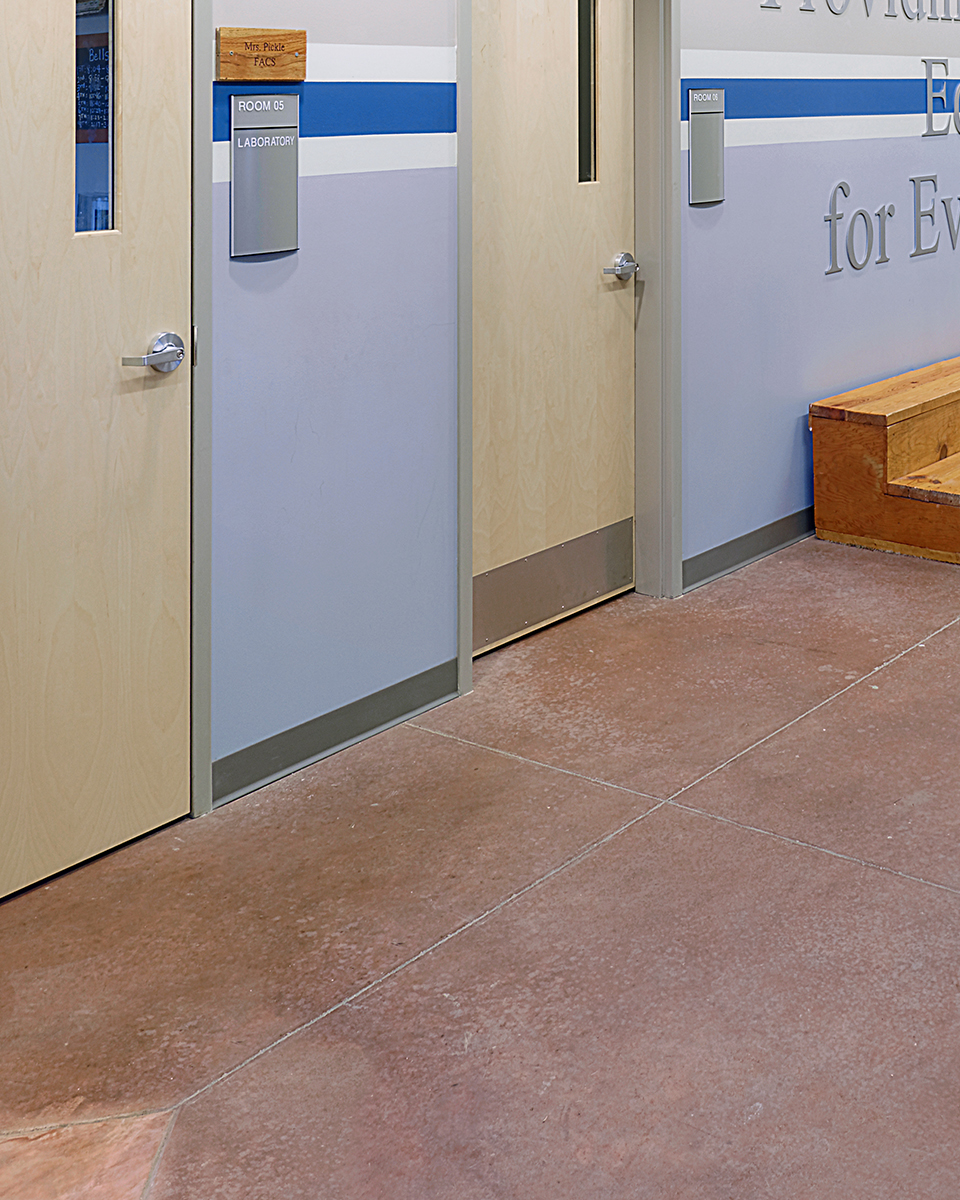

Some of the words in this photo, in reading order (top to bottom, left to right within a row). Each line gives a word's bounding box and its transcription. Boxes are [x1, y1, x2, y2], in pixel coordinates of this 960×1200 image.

[244, 42, 261, 52] Mrs.
[263, 42, 285, 52] Pickle
[254, 57, 276, 67] FACS
[693, 93, 711, 102] ROOM
[238, 101, 271, 112] ROOM
[273, 100, 285, 111] 05
[238, 136, 295, 148] LABORATORY
[823, 180, 896, 275] for
